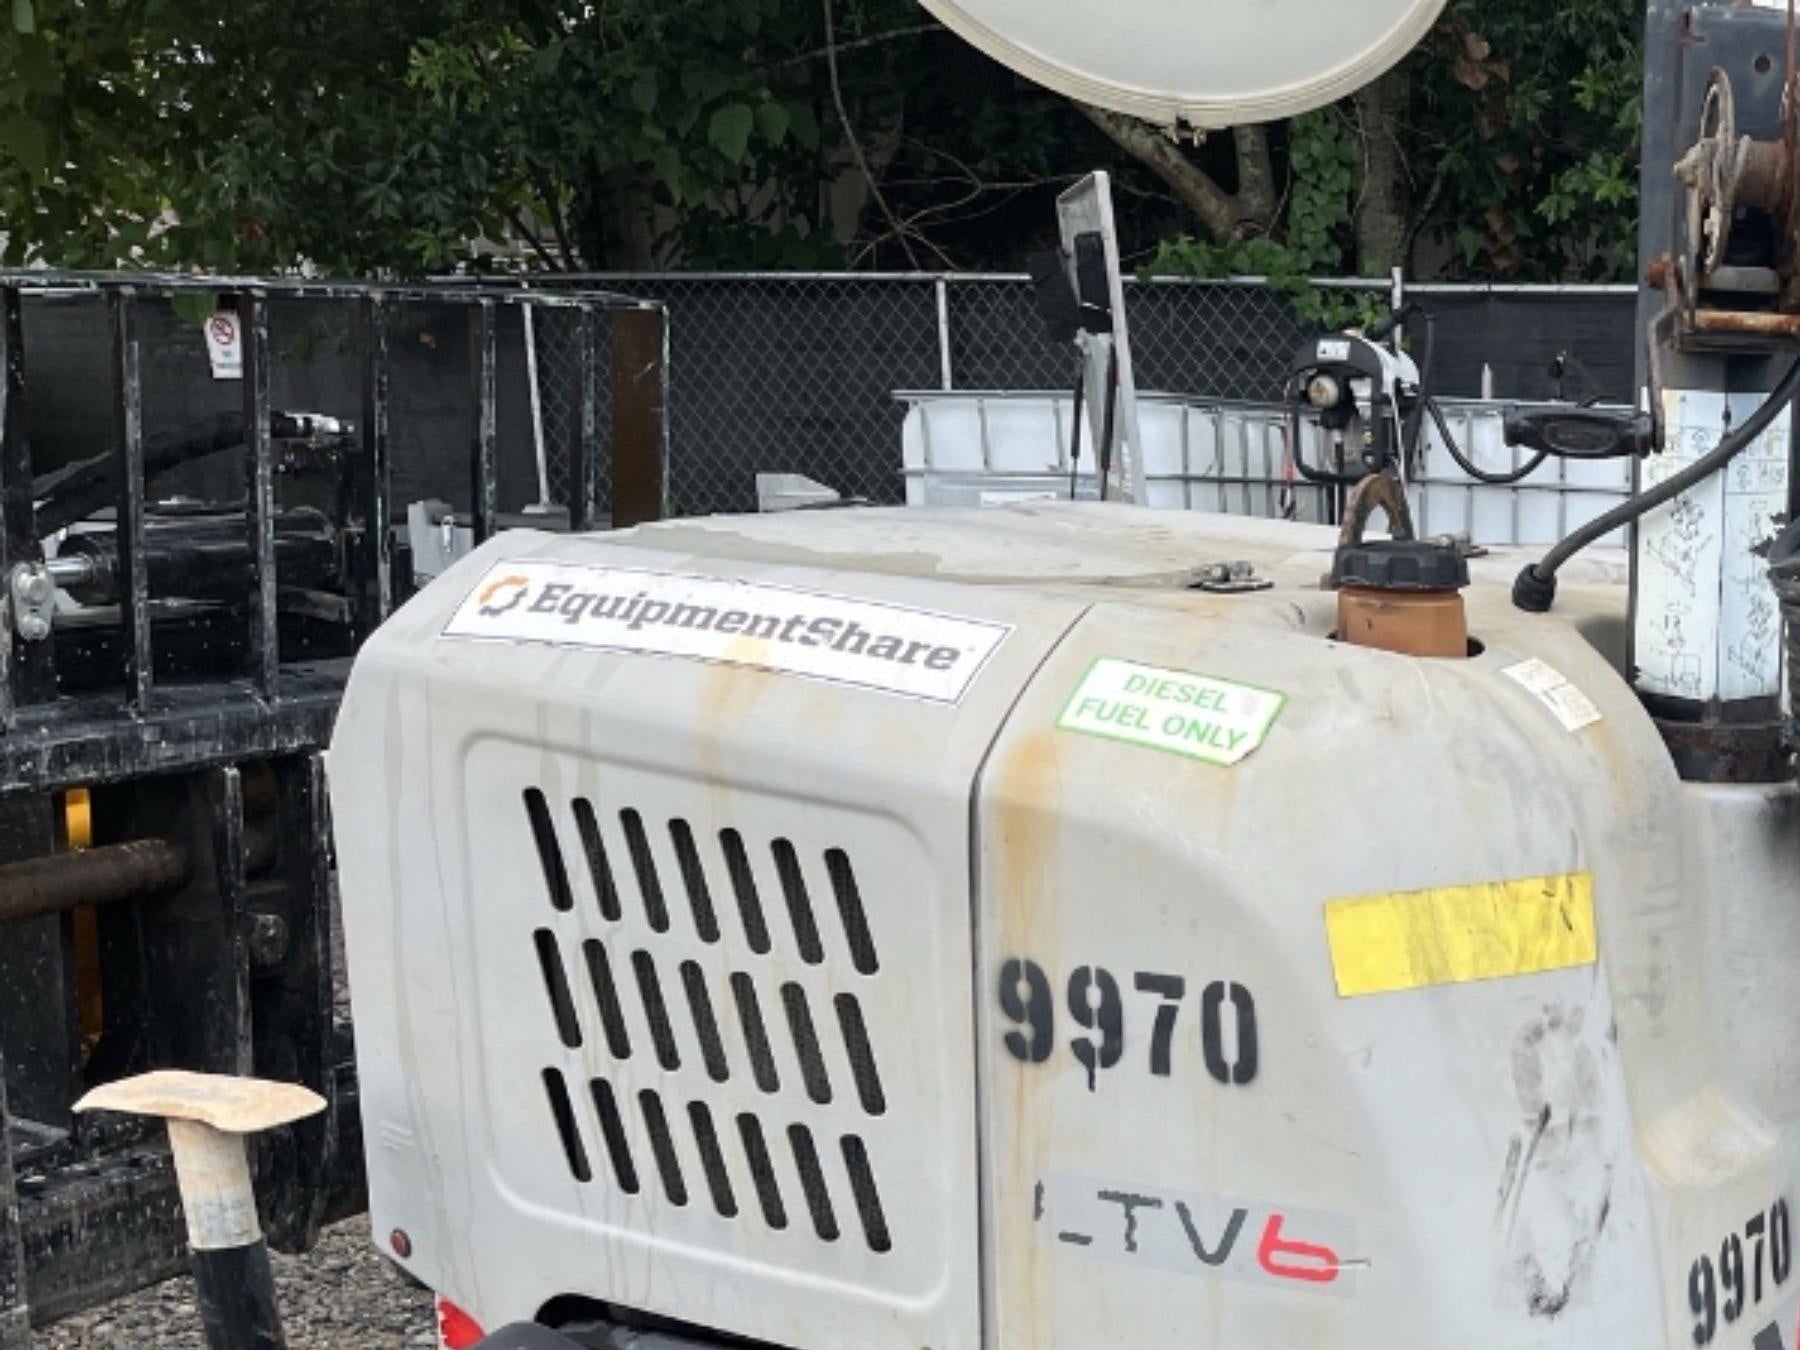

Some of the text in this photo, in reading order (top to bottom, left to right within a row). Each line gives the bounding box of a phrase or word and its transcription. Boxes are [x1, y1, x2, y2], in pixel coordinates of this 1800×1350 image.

[527, 582, 962, 672] EquipmentShare
[1075, 697, 1248, 752] FUEL ONLY
[1123, 674, 1230, 714] DIESEL
[999, 957, 1259, 1088] 9970
[1688, 1196, 1790, 1347] 9970
